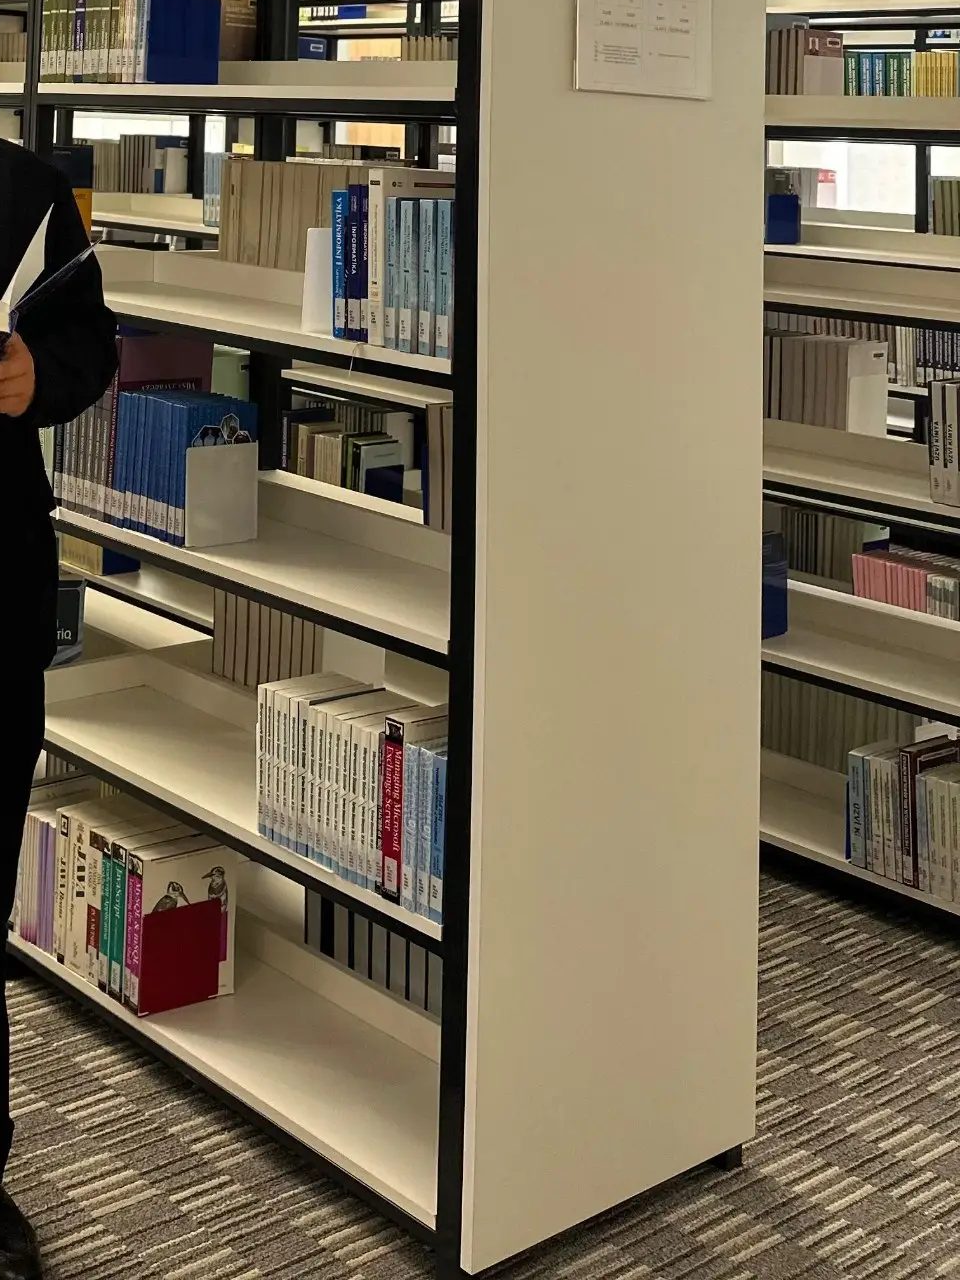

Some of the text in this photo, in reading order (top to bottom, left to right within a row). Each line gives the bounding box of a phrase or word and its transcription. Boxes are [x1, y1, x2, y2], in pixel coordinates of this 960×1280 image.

[384, 745, 393, 831] Exchange Server
[393, 749, 402, 852] Managing Microsoft
[76, 846, 86, 898] JAVA
[114, 868, 122, 919] JavaScript
[133, 882, 141, 918] MySQL
[132, 934, 140, 965] mSQL
